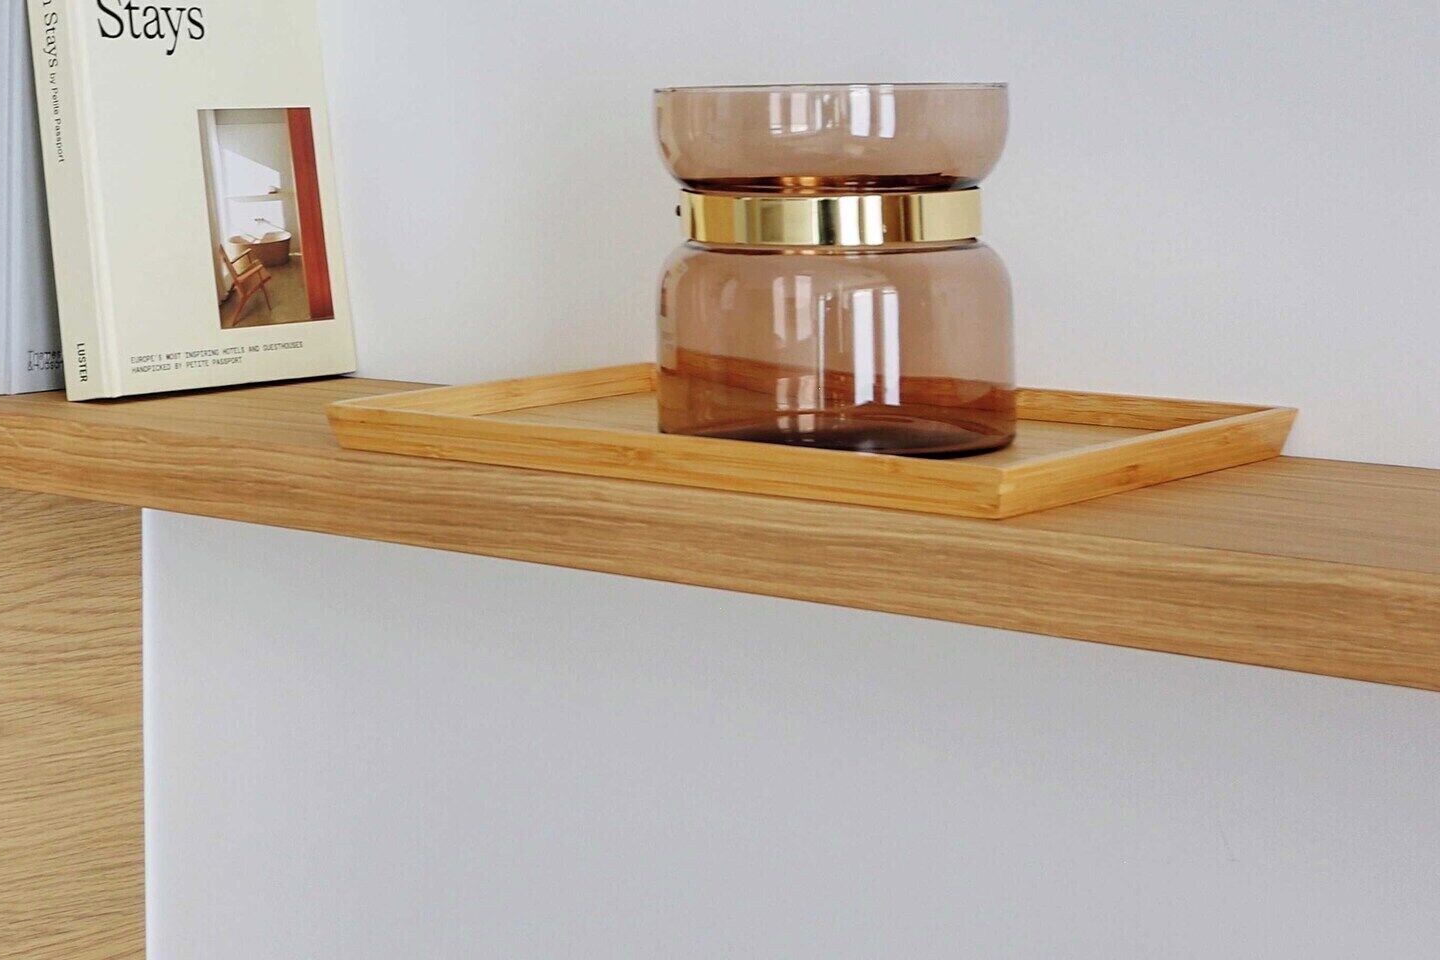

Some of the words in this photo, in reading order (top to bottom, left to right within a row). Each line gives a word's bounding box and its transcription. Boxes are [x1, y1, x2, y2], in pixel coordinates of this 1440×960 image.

[43, 12, 59, 68] Stays
[49, 72, 57, 85] by
[51, 87, 60, 116] Petite
[55, 118, 65, 163] Passport
[77, 343, 88, 382] LUSTER
[185, 349, 219, 359] INSPIRING
